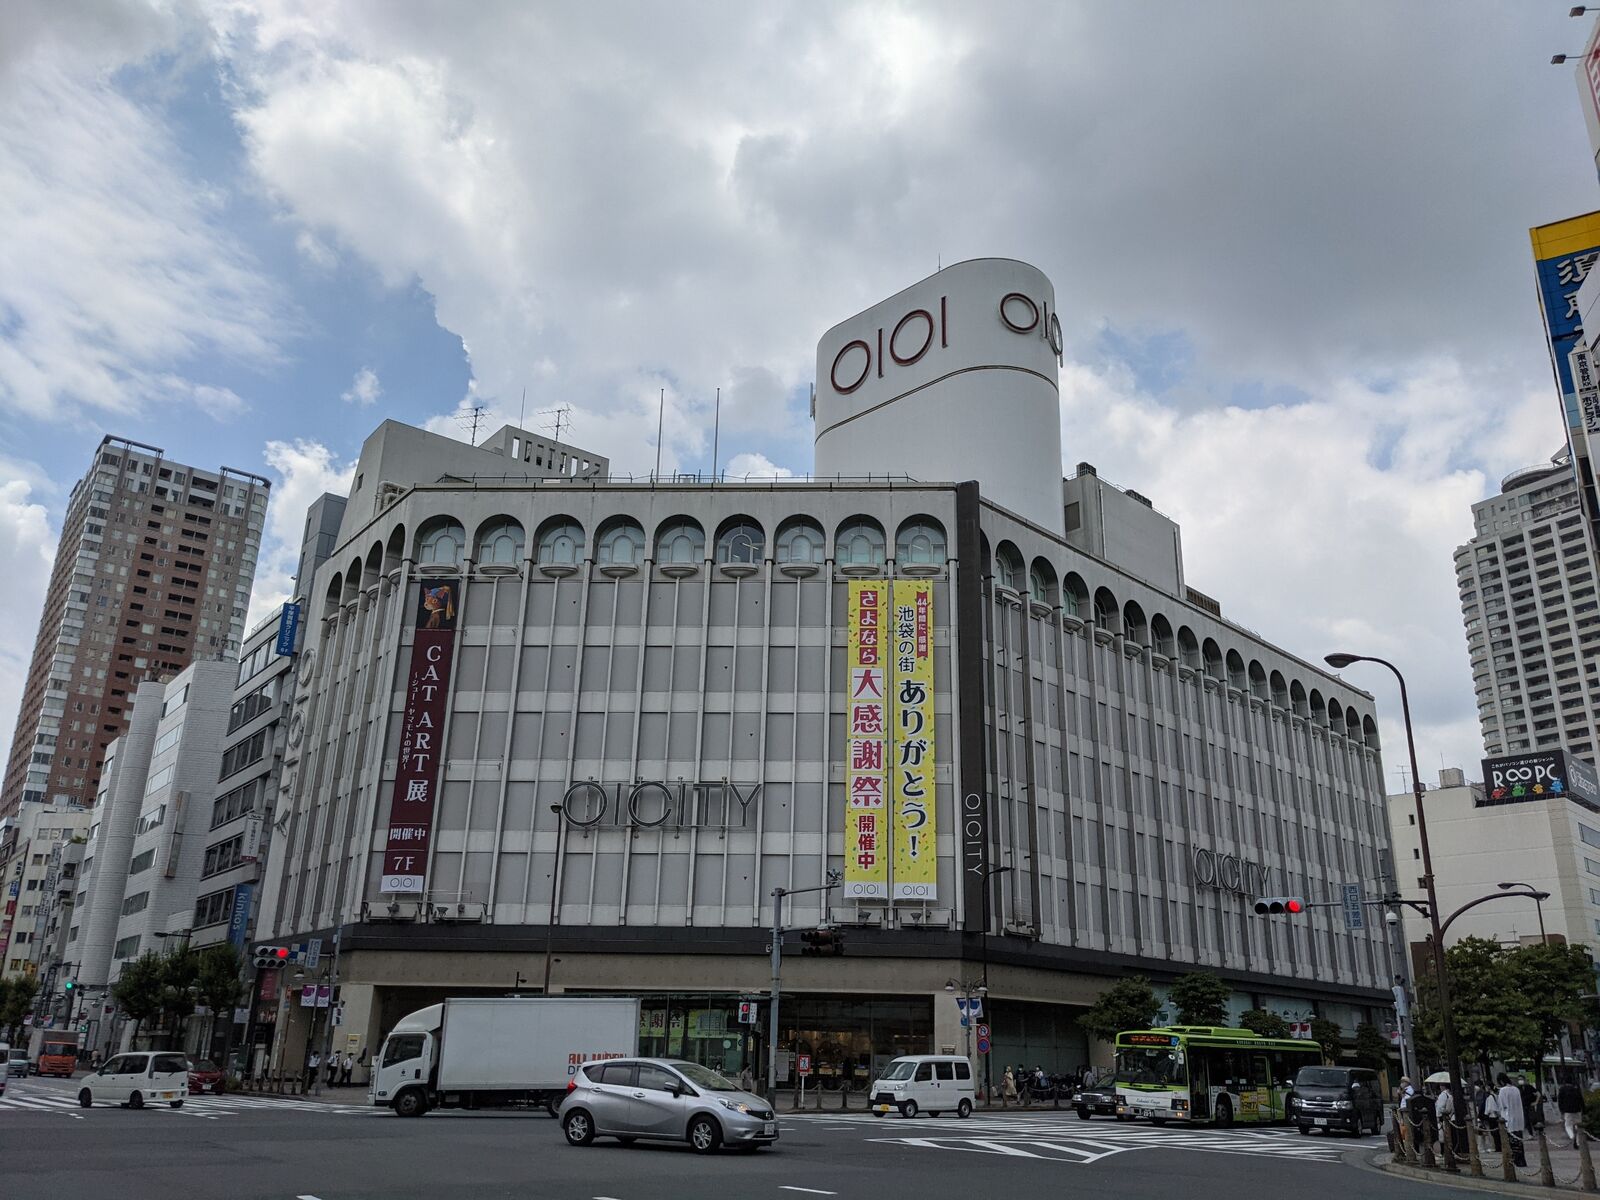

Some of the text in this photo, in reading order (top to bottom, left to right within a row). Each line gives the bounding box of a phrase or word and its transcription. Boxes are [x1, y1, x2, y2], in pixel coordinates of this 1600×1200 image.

[898, 606, 915, 673] 池袋の街
[852, 592, 882, 870] さよなら 大感謝祭 開催中
[389, 828, 426, 841] 開催中
[393, 856, 415, 871] 7F
